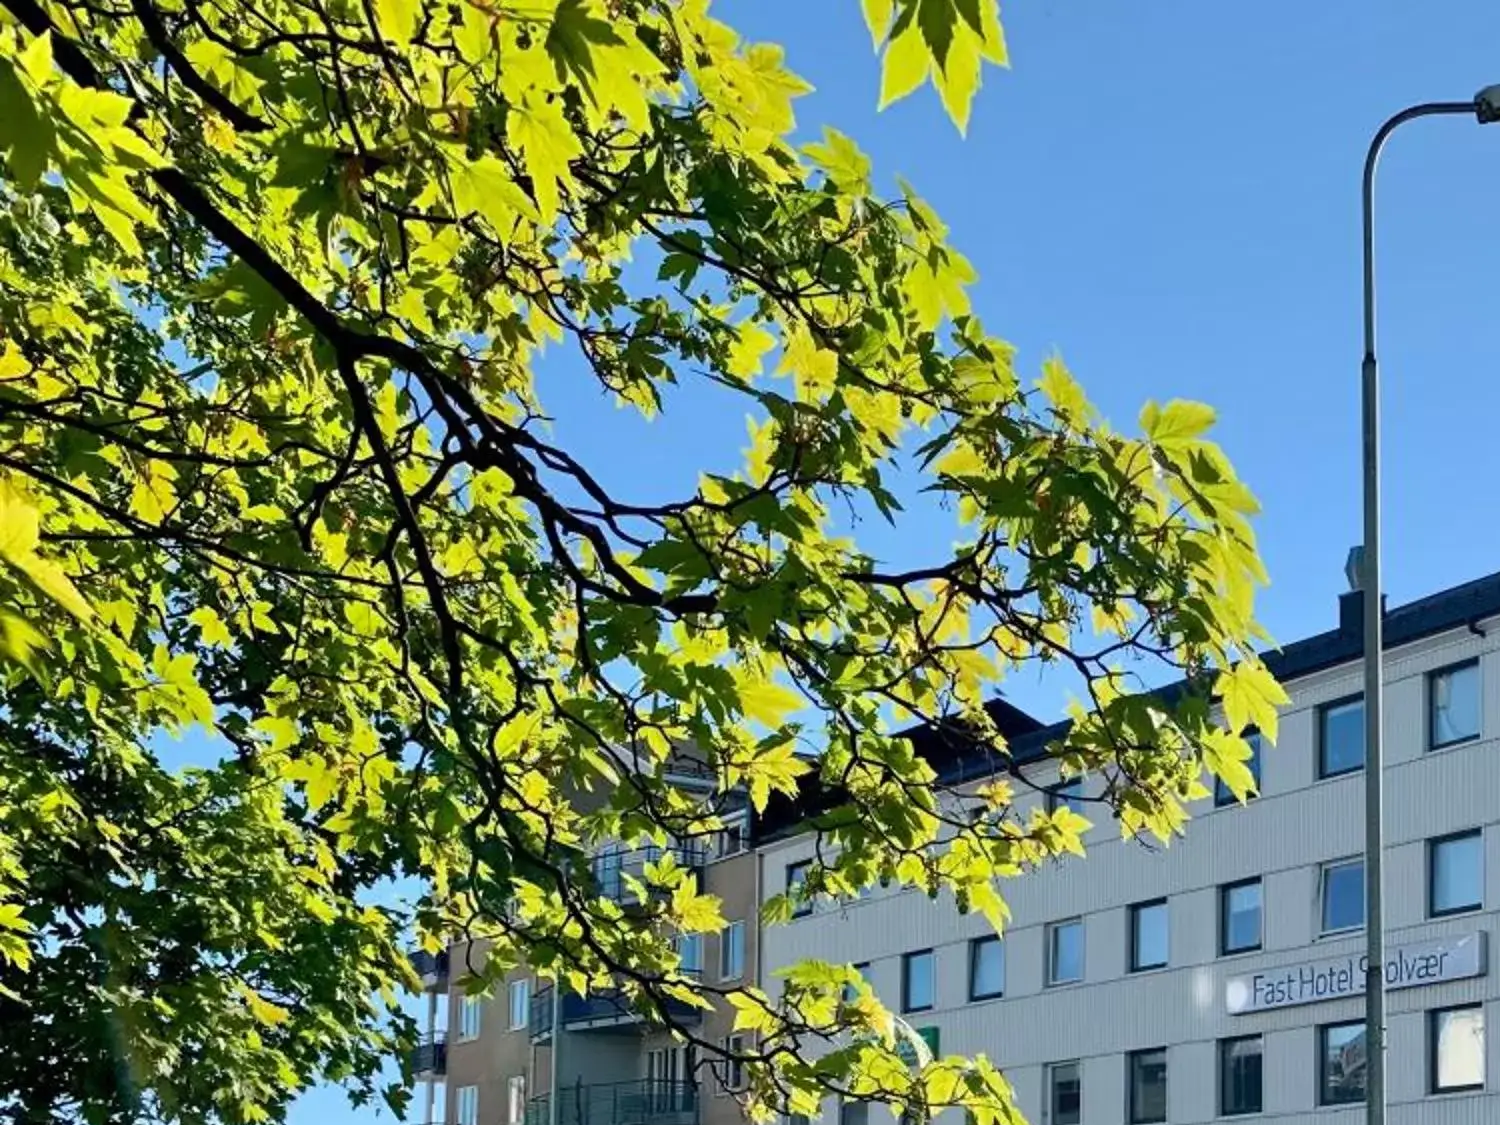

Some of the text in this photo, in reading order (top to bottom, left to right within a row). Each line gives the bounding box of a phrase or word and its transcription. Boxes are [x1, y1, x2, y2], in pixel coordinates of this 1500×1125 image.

[1253, 950, 1448, 1005] Fast Hotel Solvær
